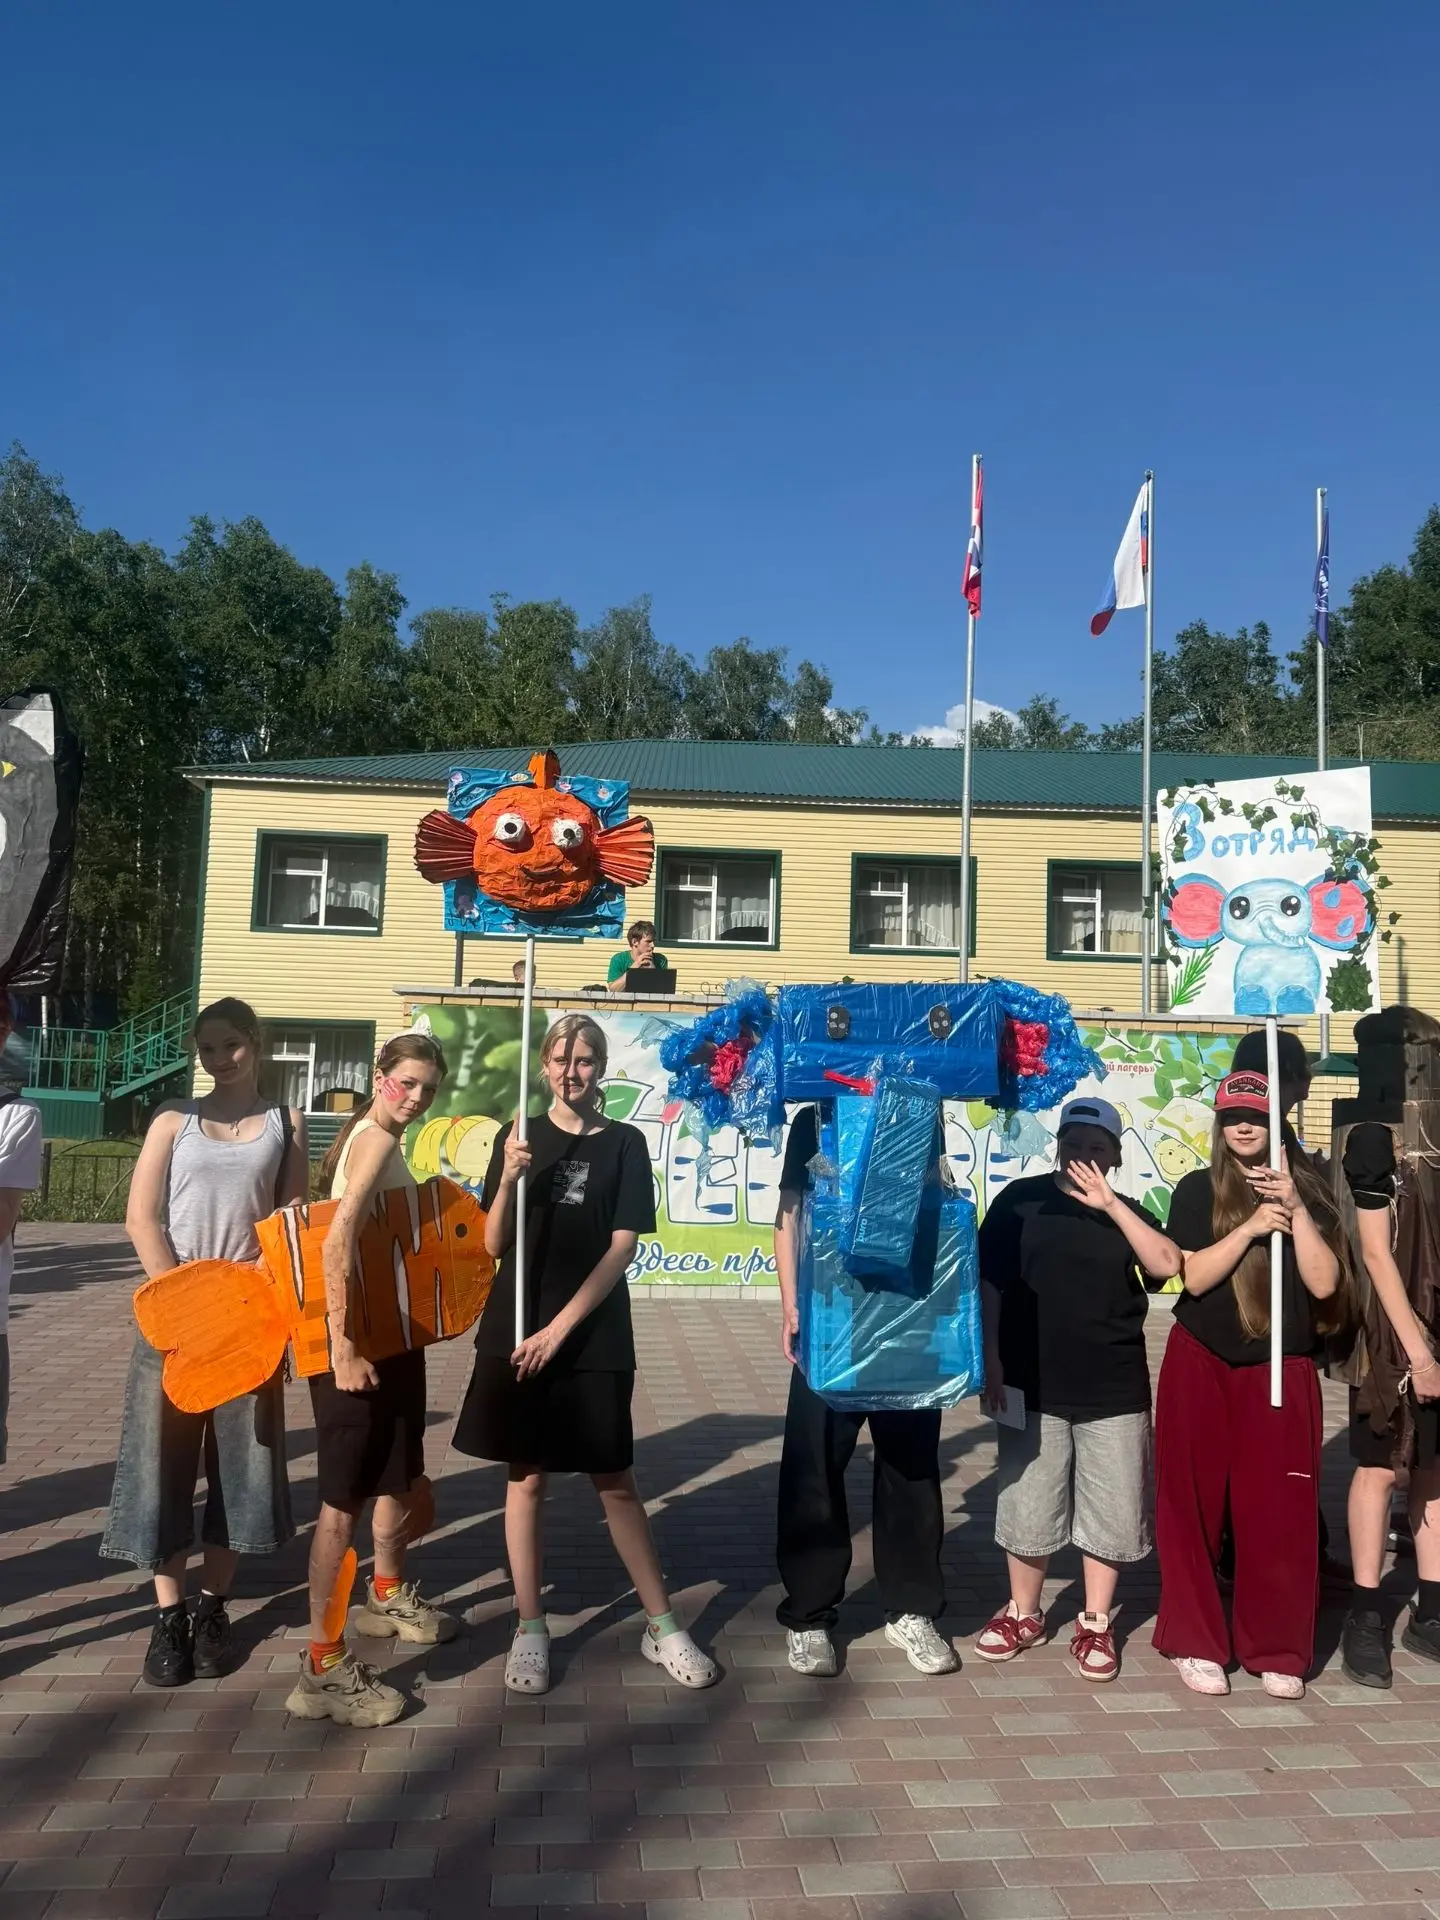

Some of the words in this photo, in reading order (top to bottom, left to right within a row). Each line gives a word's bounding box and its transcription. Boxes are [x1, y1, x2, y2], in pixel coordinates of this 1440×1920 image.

[1211, 824, 1316, 858] отряд
[1117, 1064, 1155, 1075] лагерь»
[856, 1218, 868, 1243] buro
[627, 1242, 716, 1280] Здесь
